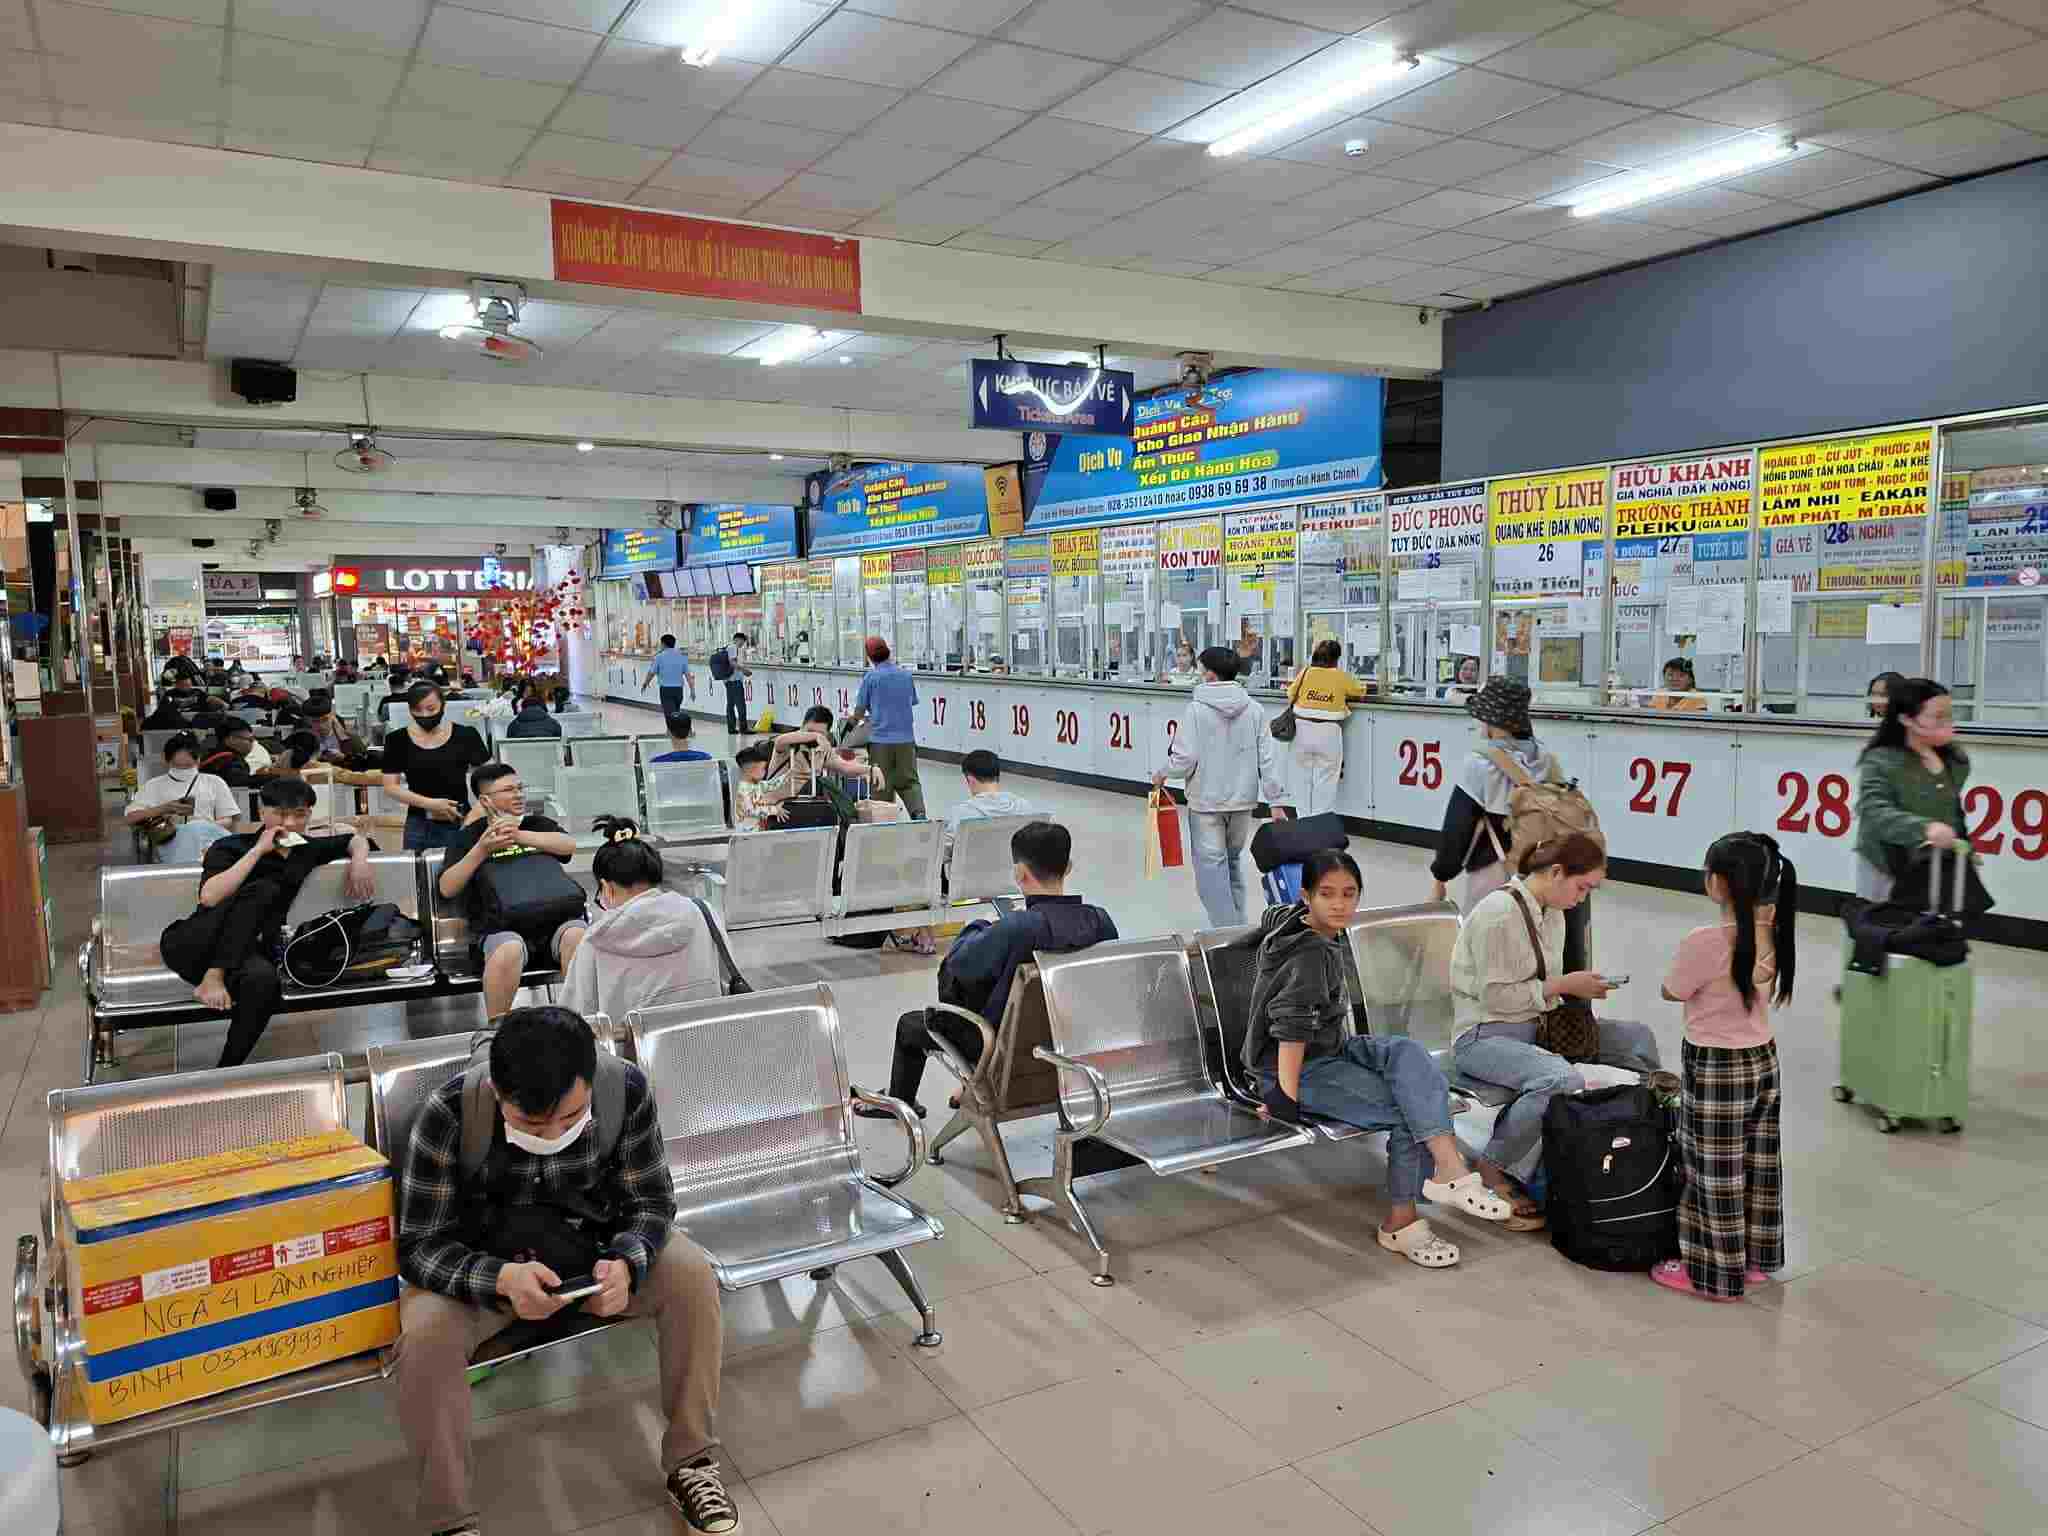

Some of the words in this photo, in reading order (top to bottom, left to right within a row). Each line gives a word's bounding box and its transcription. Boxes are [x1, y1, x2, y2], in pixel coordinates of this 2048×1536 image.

[1137, 438, 1164, 453] Kho
[1169, 431, 1202, 448] Giao
[1914, 439, 1930, 452] AN
[1618, 464, 1663, 489] HỮU
[1668, 457, 1752, 484] KHÁNH
[1893, 456, 1908, 469] AN
[1189, 482, 1215, 500] 0938
[1218, 479, 1232, 497] 69
[1235, 477, 1249, 495] 69
[1252, 475, 1267, 492] 38
[1555, 480, 1605, 509] LINH
[1616, 490, 1634, 501] GIA
[1821, 477, 1841, 491] KON
[1844, 475, 1867, 489] TUM
[1616, 501, 1682, 524] TRƯỜNG
[1688, 496, 1750, 518] THÀNH
[1807, 494, 1840, 508] NHI
[1860, 487, 1928, 503] EAKAR
[1302, 519, 1355, 533] PLEIKU
[1392, 505, 1425, 532] ĐỨC
[1429, 503, 1484, 529] PHONG
[1616, 519, 1696, 537] PLEIKU
[1726, 517, 1749, 529] LAI)
[1391, 536, 1410, 553] TUY
[1412, 532, 1432, 551] ĐỨC
[1660, 536, 1681, 553] 27
[1826, 522, 1850, 545] 28
[1161, 552, 1188, 570] KON
[1191, 550, 1222, 567] TUM
[1427, 551, 1441, 569] 25
[1537, 544, 1554, 562] 26
[932, 696, 947, 727] 17
[969, 700, 986, 731] 18
[1012, 704, 1030, 737] 19
[1056, 710, 1079, 745] 20
[1109, 712, 1133, 750] 21
[1399, 739, 1443, 790] 25
[1630, 757, 1692, 817] 27
[1777, 771, 1851, 838] 28
[1964, 785, 2048, 860] 29
[221, 1286, 240, 1312] 4
